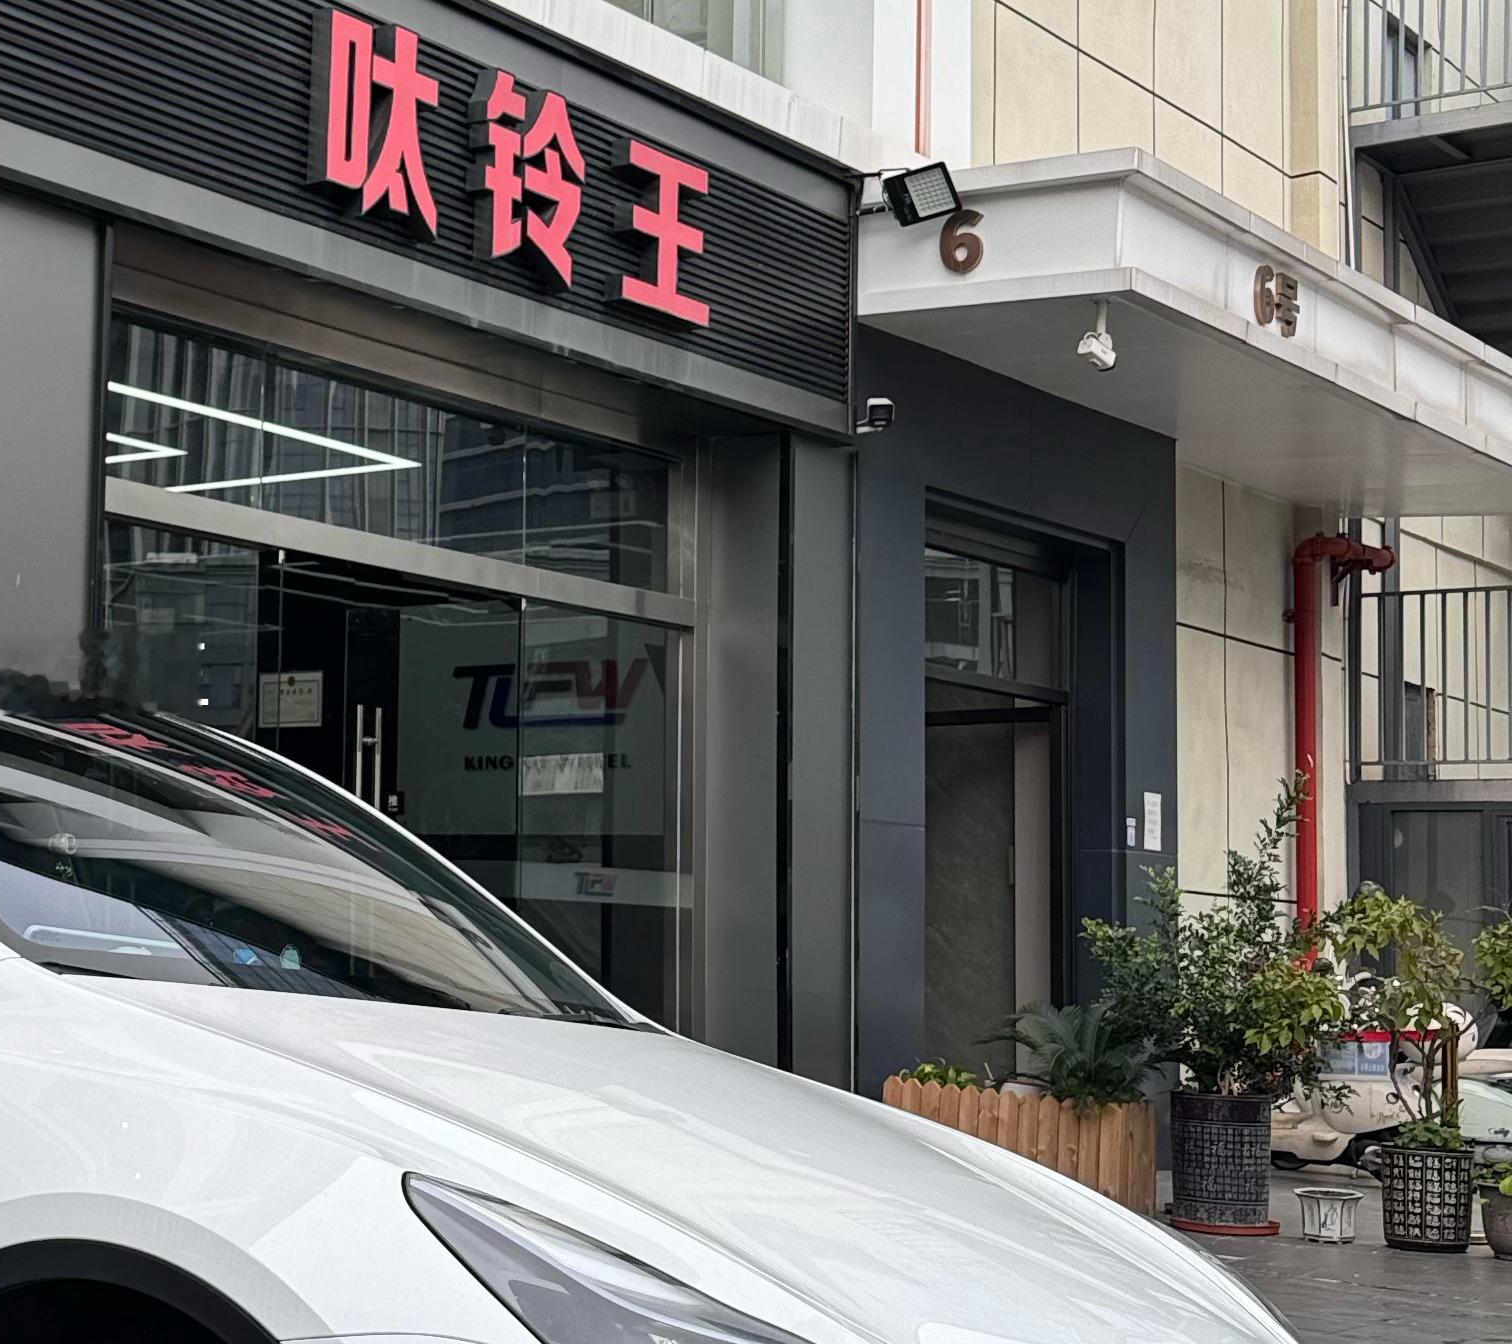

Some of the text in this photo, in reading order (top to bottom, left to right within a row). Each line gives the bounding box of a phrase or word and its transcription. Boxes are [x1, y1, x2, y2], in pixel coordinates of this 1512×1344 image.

[324, 8, 710, 328] 呔铃王
[939, 209, 984, 274] 6
[464, 754, 515, 771] KING
